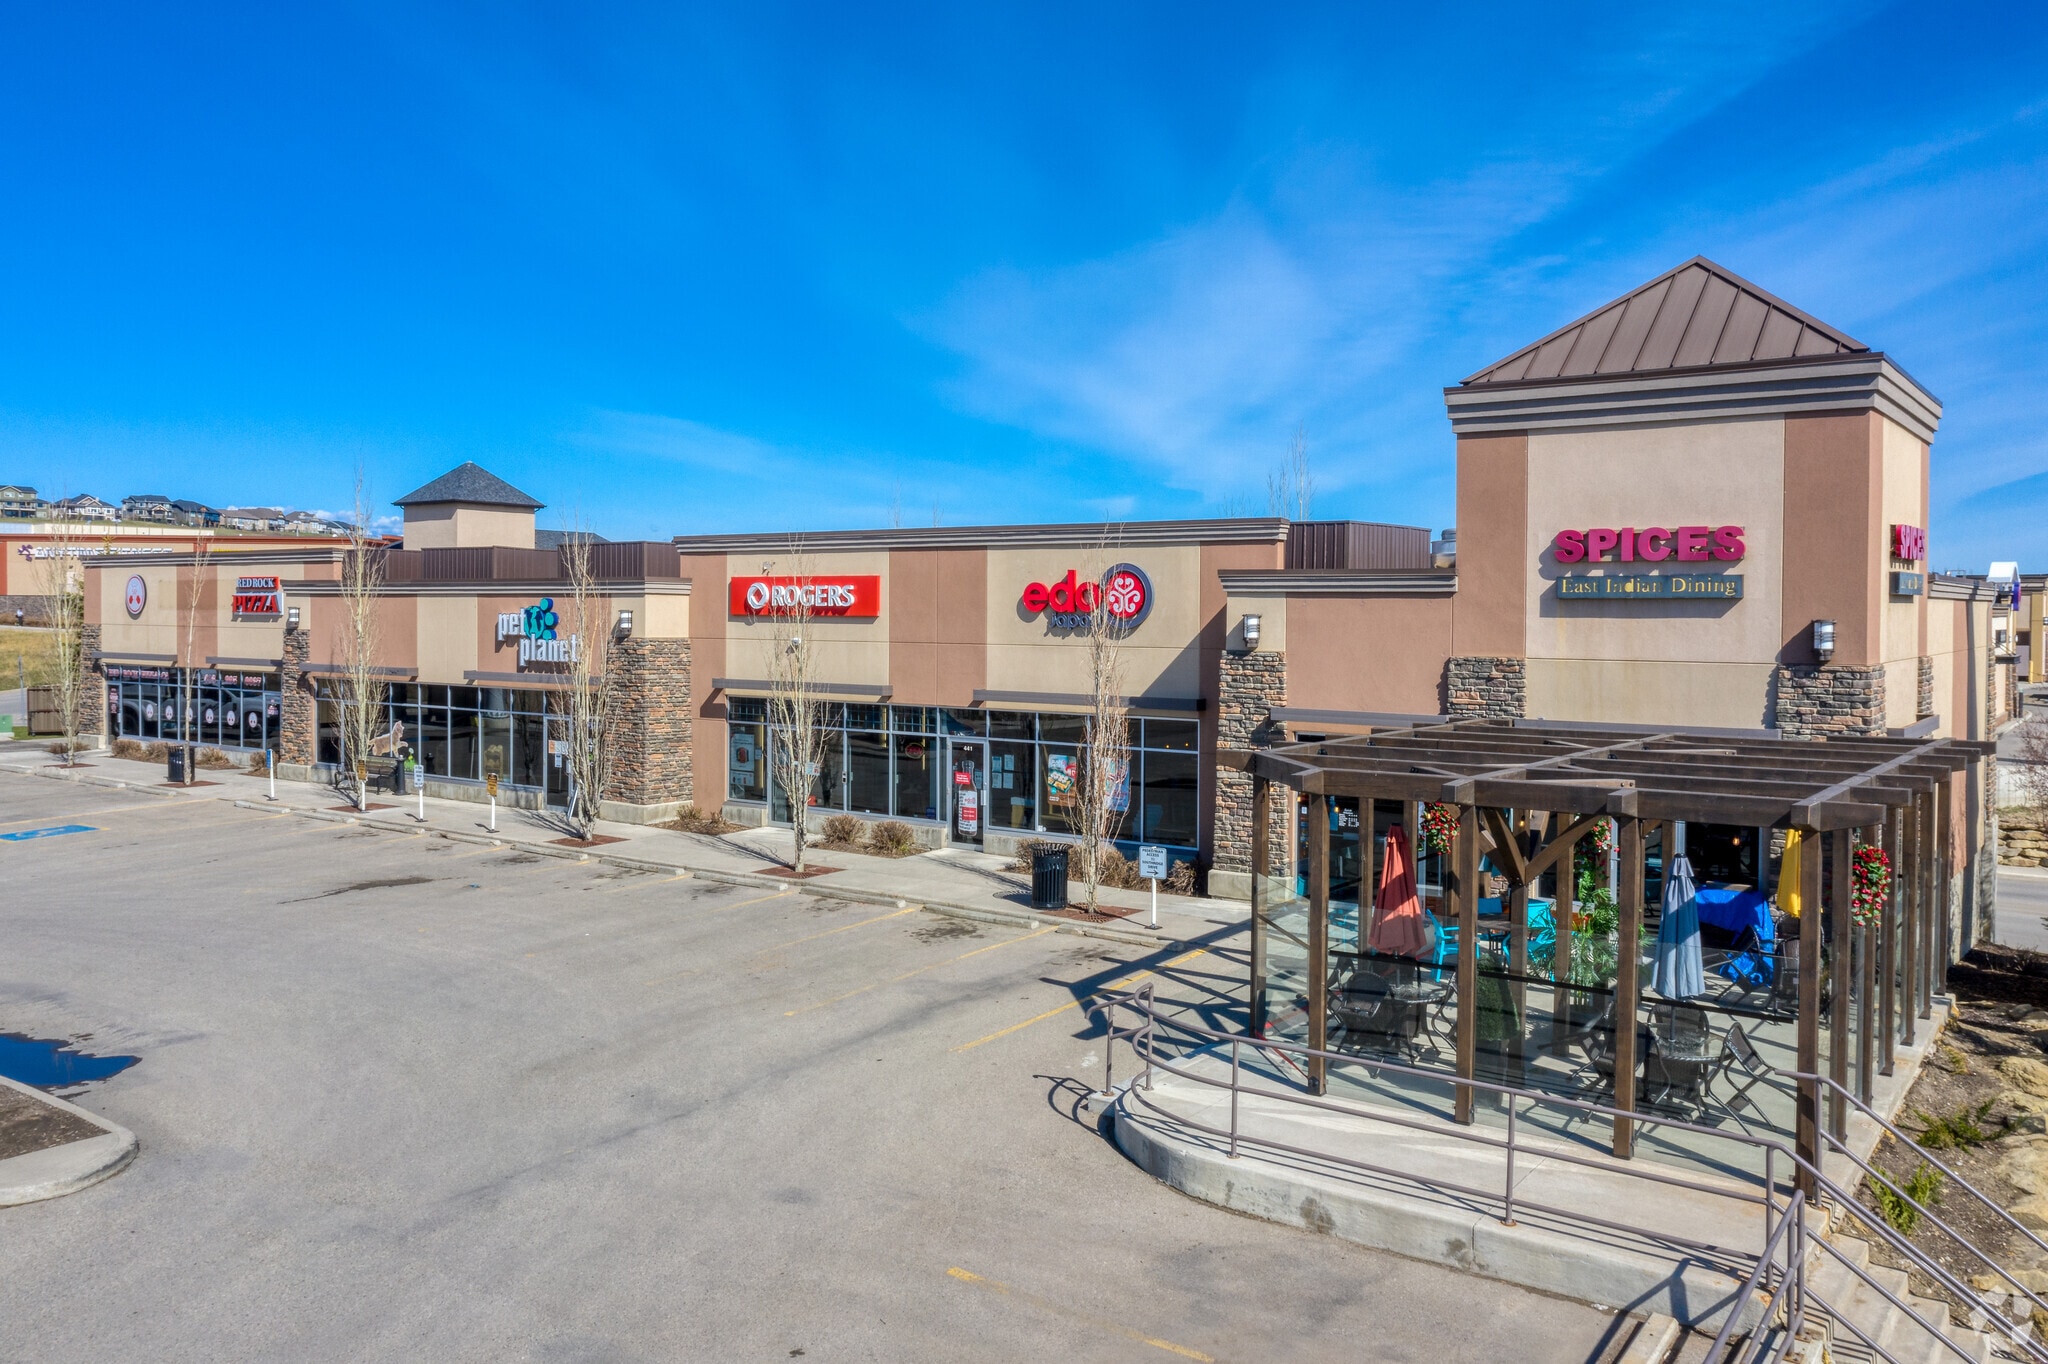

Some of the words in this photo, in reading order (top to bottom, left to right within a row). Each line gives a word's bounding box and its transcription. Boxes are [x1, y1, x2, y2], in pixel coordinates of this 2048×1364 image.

[1554, 525, 1746, 563] SPICES
[771, 585, 855, 607] ROGERS
[1023, 569, 1102, 613] edo
[1561, 578, 1598, 593] East
[1606, 578, 1662, 593] Indian
[1671, 577, 1736, 596] Dining
[232, 595, 278, 613] PIZZA
[498, 608, 526, 641] pet
[1049, 613, 1101, 630] japa
[520, 633, 578, 667] planet
